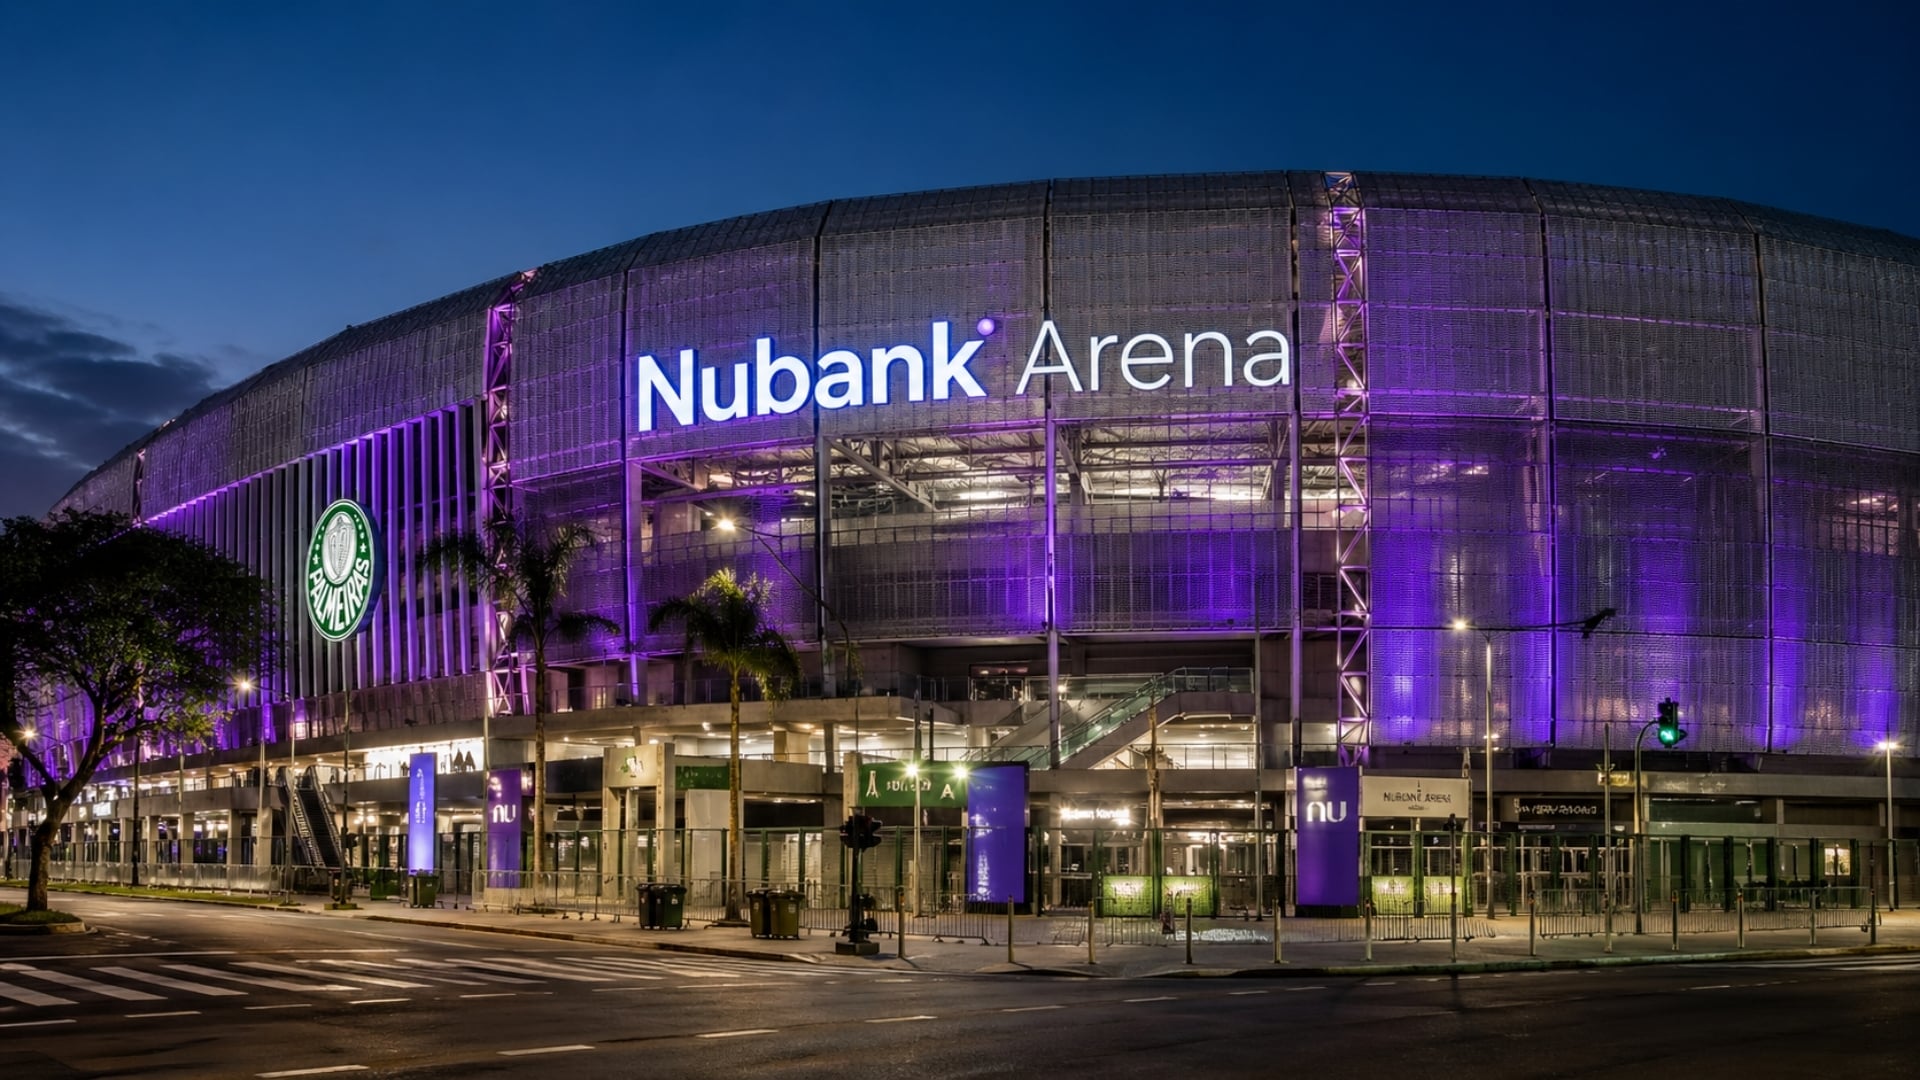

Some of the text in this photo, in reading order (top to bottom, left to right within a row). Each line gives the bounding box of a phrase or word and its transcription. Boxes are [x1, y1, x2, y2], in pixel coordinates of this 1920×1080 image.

[637, 319, 1291, 432] Nubank Arena
[309, 558, 370, 631] PALMEIRAS
[492, 804, 517, 823] nu
[1306, 800, 1347, 823] nu
